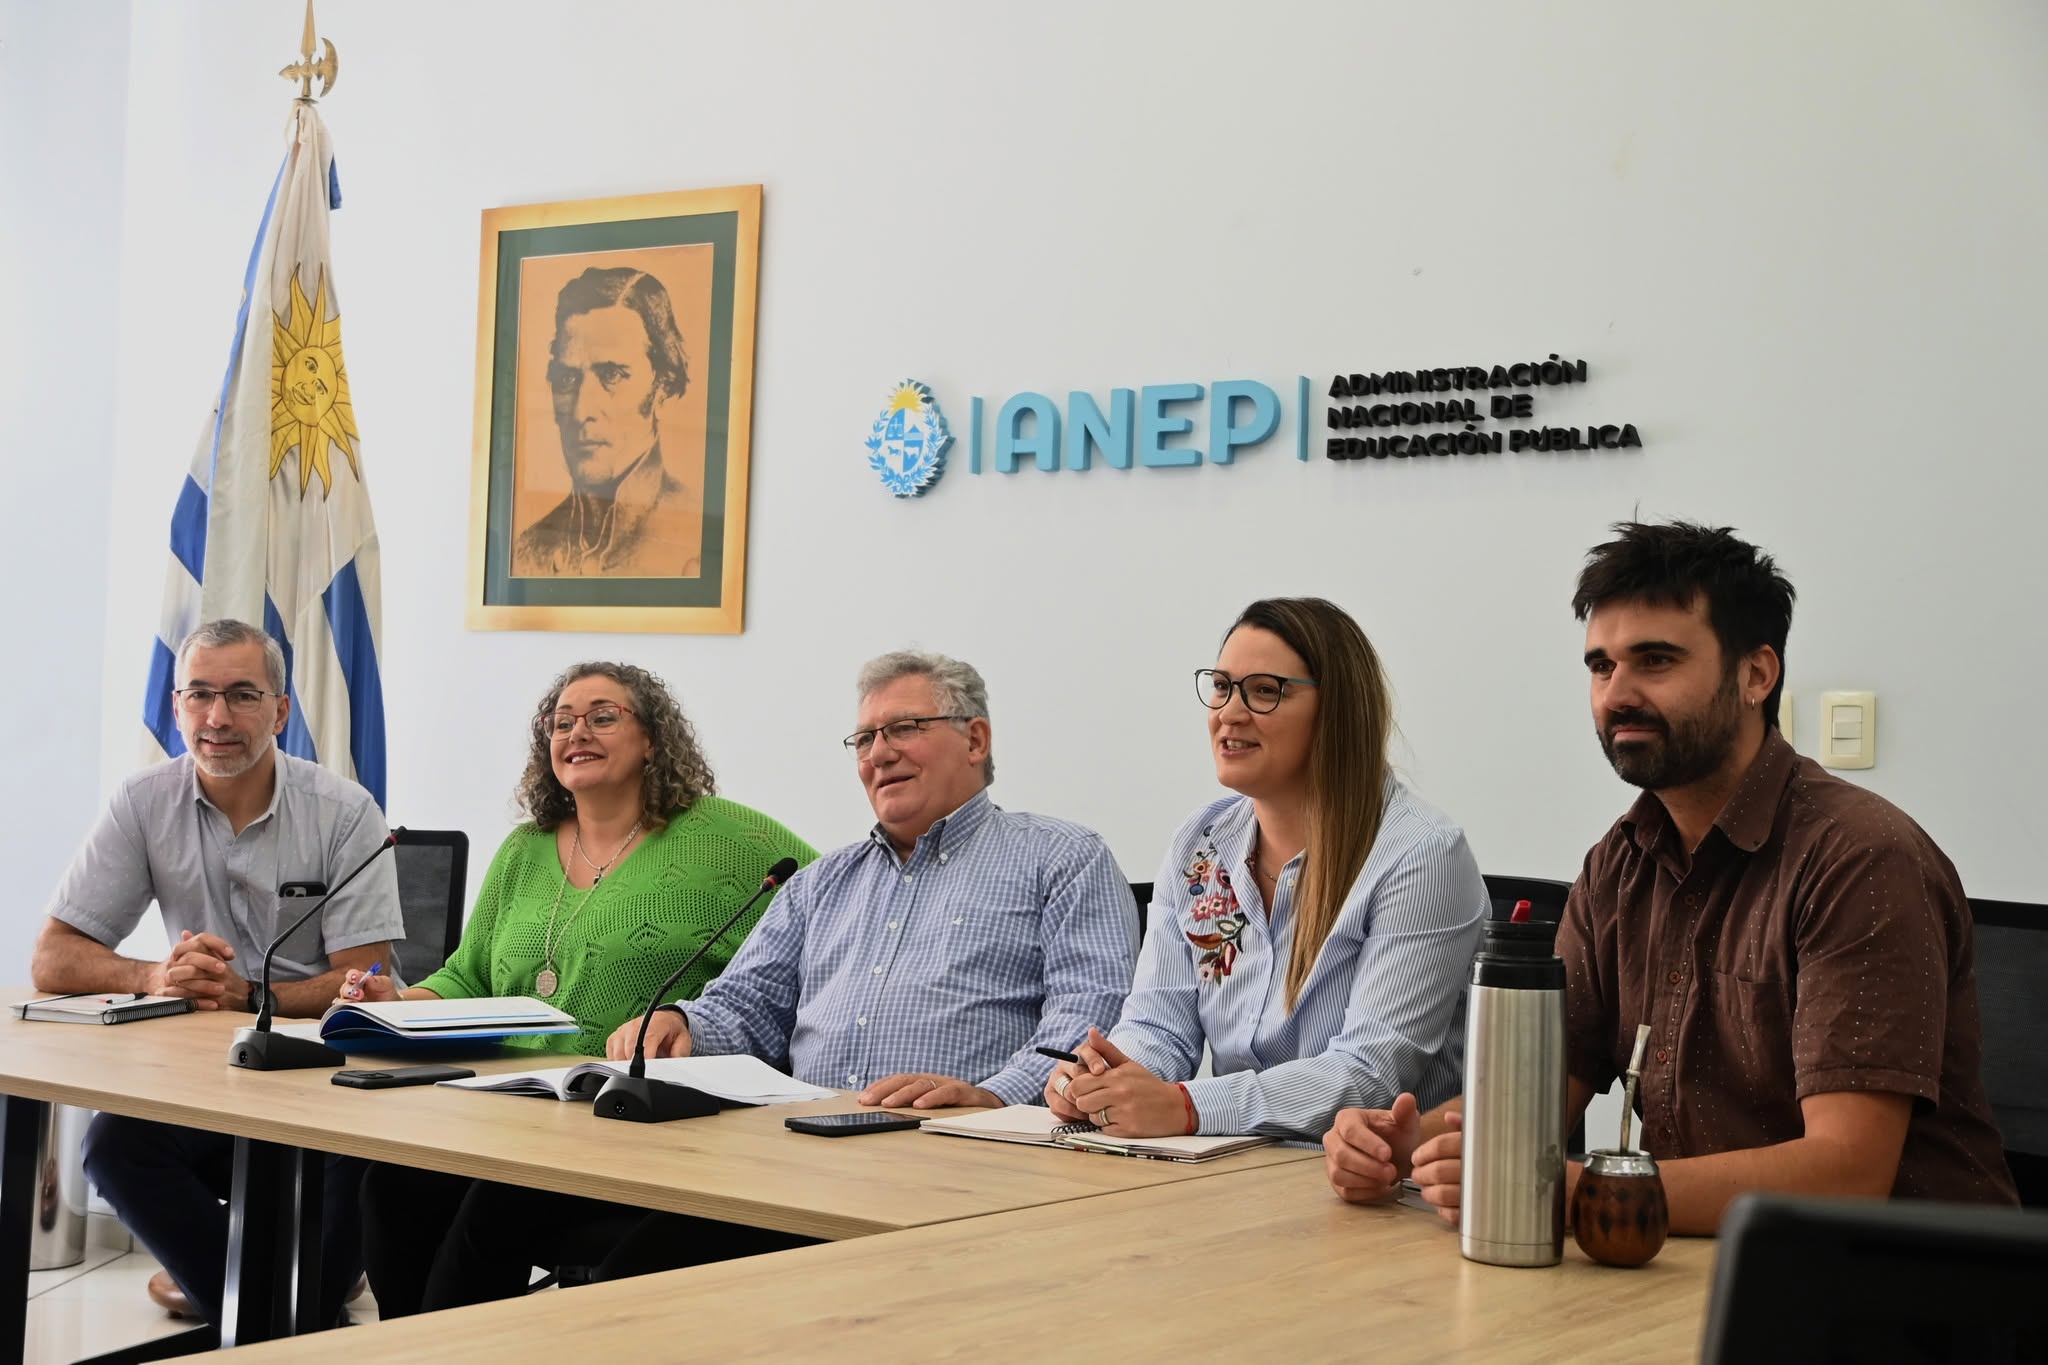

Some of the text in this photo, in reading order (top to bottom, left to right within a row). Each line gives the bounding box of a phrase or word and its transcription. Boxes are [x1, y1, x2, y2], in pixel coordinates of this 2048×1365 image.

[1328, 353, 1588, 398] ADMINISTRACIÓN
[995, 379, 1282, 474] ANEP
[1327, 393, 1534, 429] NACIONAL DE
[1326, 423, 1502, 460] EDUCACIÓN
